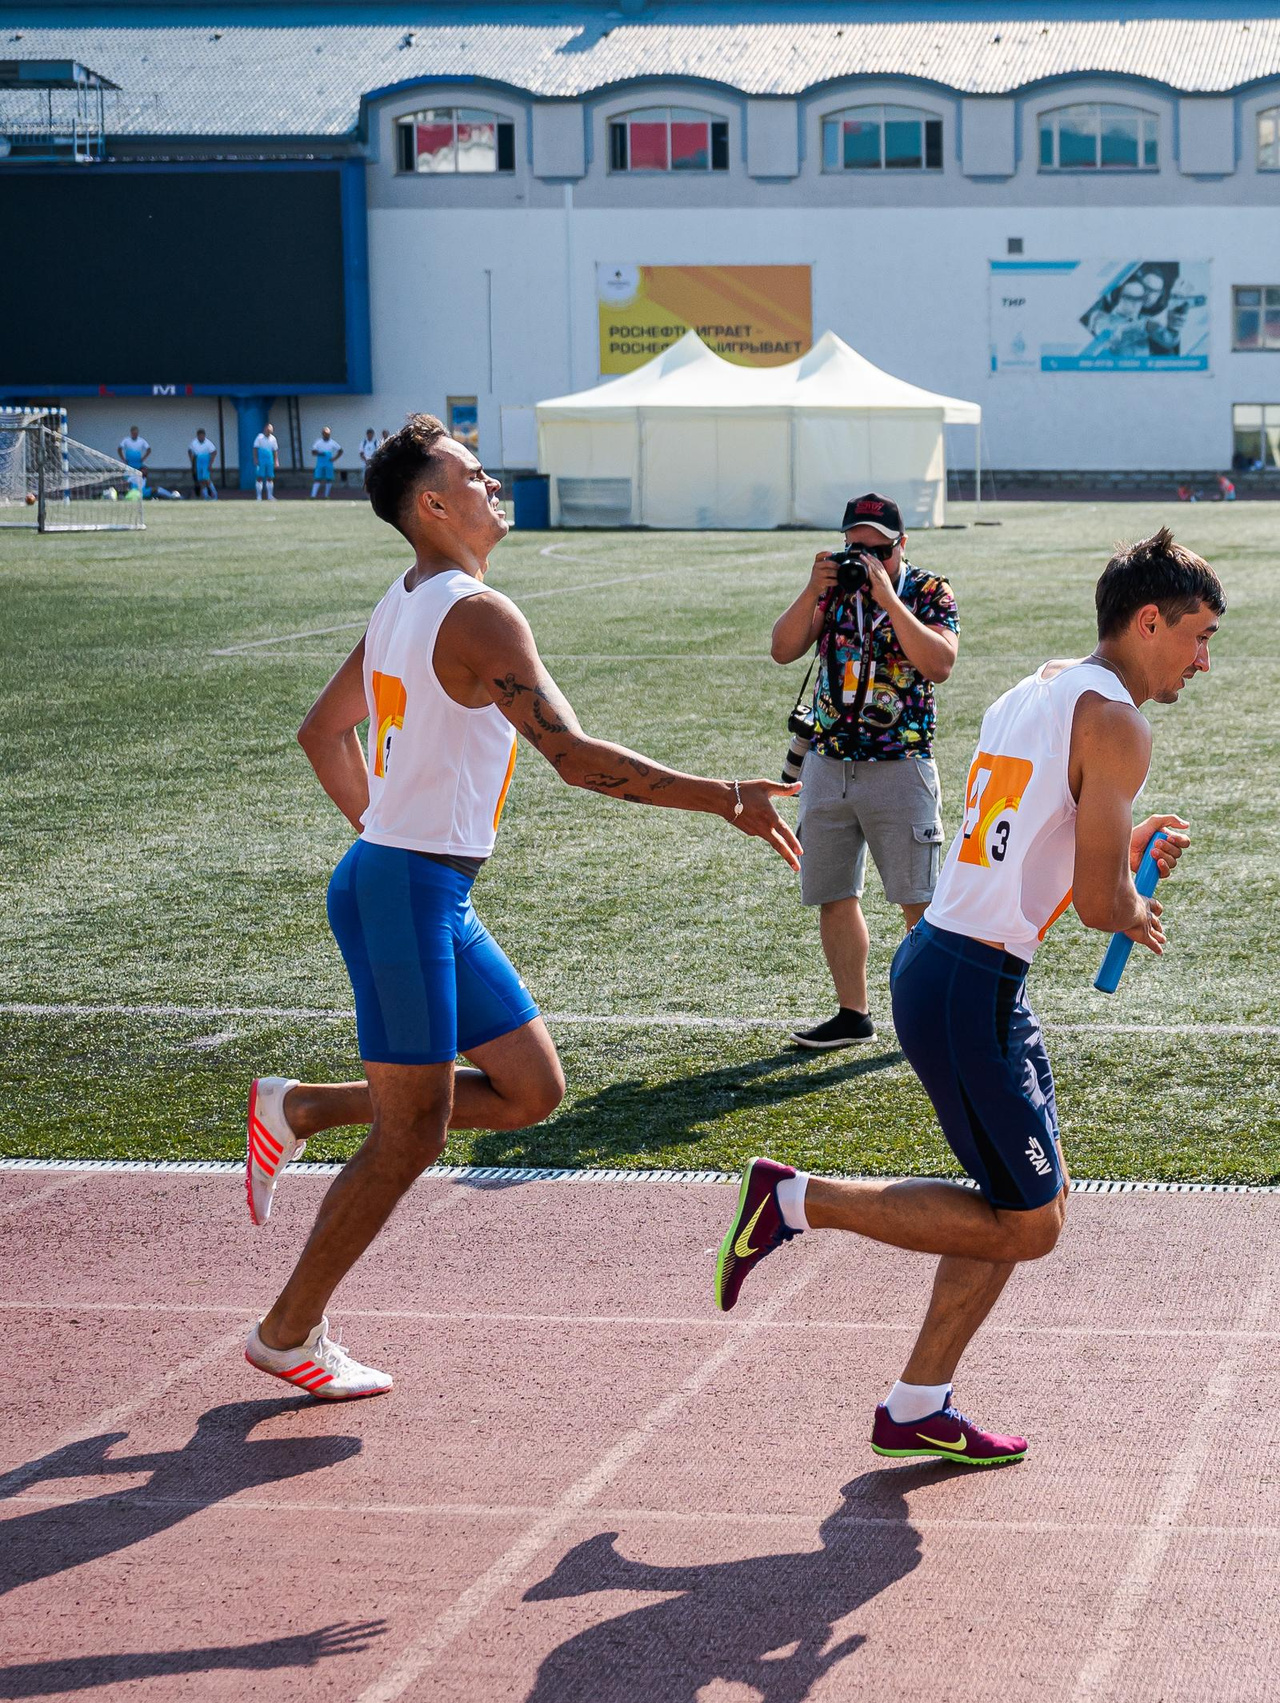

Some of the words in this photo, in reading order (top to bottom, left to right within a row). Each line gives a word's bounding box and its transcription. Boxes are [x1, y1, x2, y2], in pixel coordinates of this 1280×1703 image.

[1002, 298, 1026, 307] ТИР
[696, 325, 752, 337] ИГРАЕТ
[708, 340, 801, 353] ЫИГРЫВАЕТ
[991, 820, 1010, 862] 3
